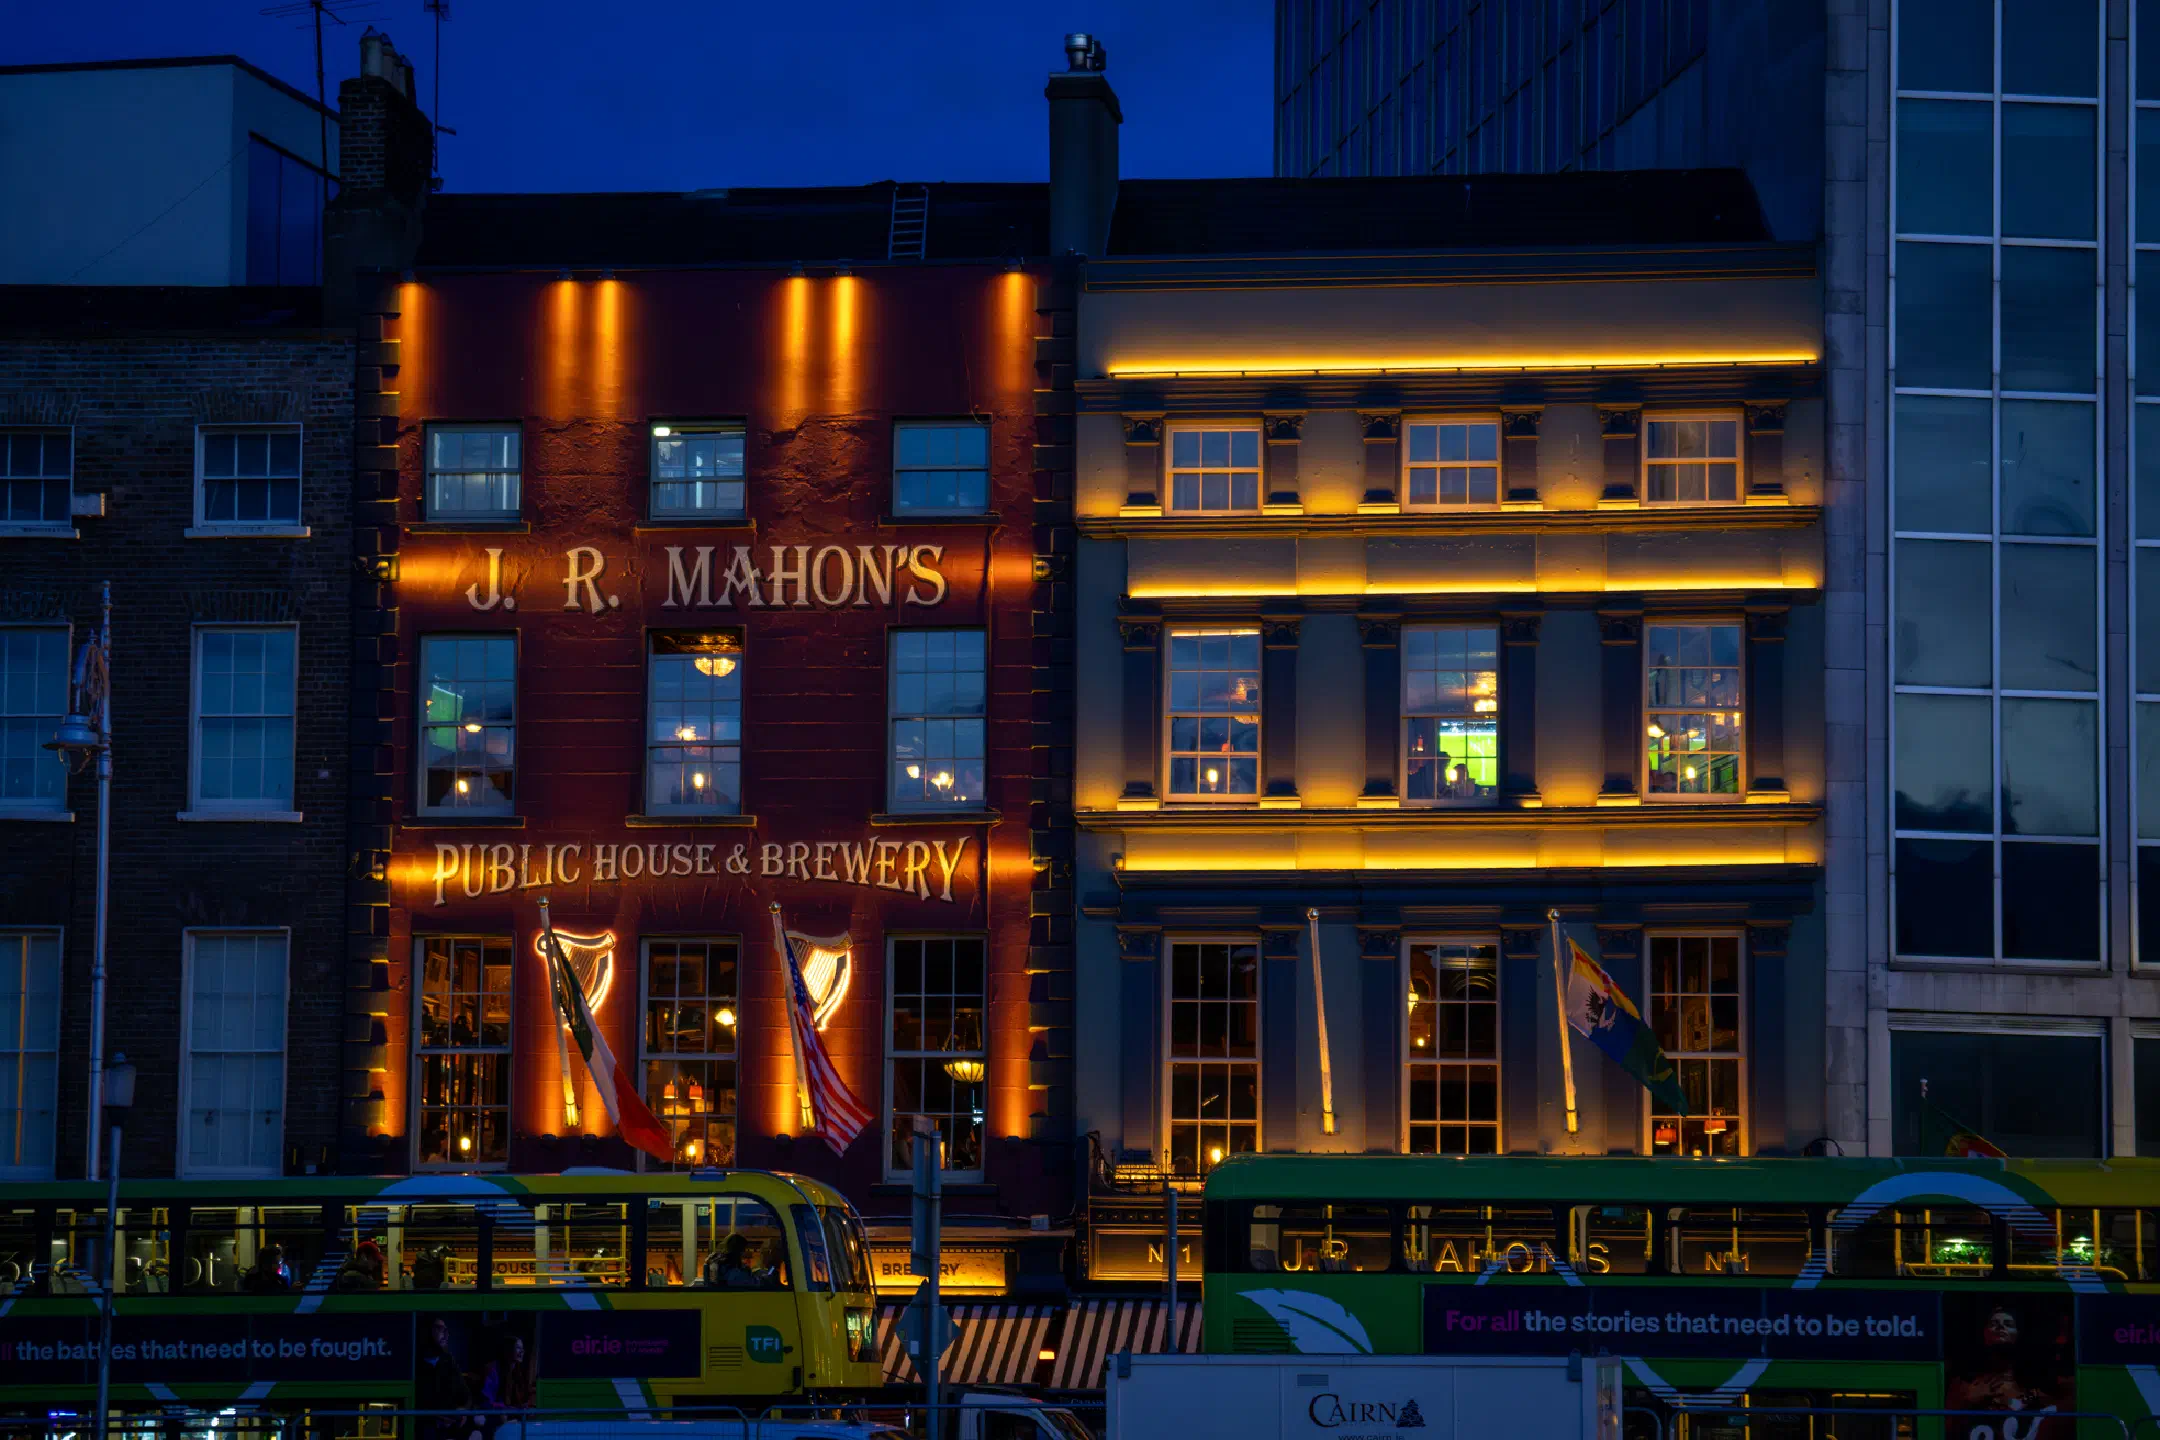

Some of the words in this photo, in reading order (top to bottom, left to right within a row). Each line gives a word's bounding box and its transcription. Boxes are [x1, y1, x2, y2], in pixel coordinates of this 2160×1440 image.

[465, 548, 517, 611] J.
[562, 546, 620, 614] R.
[660, 544, 947, 606] MAHON'S
[432, 843, 582, 907] PUBLIC
[592, 843, 718, 881] HOUSE
[726, 843, 753, 875] &
[760, 835, 972, 902] BREWERY
[881, 1262, 960, 1276] BRERY
[1446, 1310, 1487, 1332] For
[1490, 1310, 1520, 1332] all
[1524, 1310, 1566, 1333] the
[1571, 1310, 1659, 1333] stories
[1664, 1311, 1720, 1334] that
[1724, 1313, 1790, 1335] need
[1793, 1315, 1822, 1336] to
[1826, 1314, 1860, 1336] be
[1864, 1314, 1925, 1338] told.
[16, 1340, 54, 1360] the
[56, 1339, 137, 1360] battes
[140, 1338, 185, 1360] that
[189, 1338, 247, 1359] need
[250, 1339, 277, 1358] to
[279, 1338, 306, 1358] be
[311, 1337, 393, 1361] fought.
[750, 1336, 780, 1352] TFI
[1308, 1393, 1397, 1427] CAIRN
